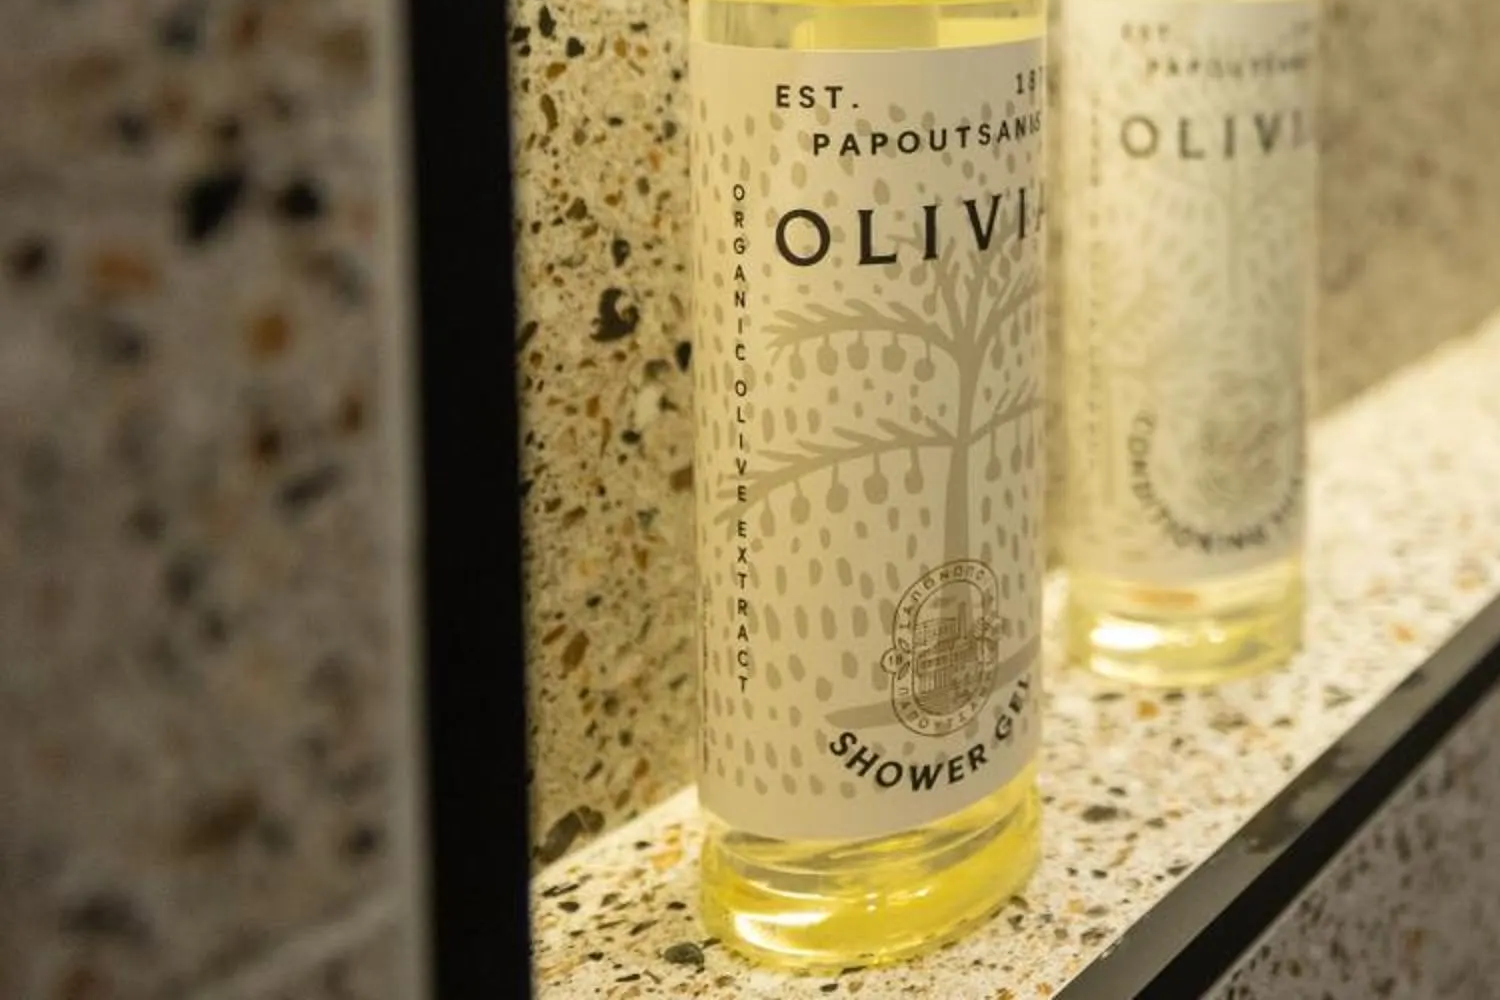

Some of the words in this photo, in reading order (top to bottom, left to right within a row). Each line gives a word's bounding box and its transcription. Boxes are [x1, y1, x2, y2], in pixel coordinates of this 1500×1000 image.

[775, 85, 860, 109] EST.
[1015, 66, 1043, 96] 18
[1120, 108, 1306, 161] OLIVI
[732, 184, 746, 361] ORGANIC
[734, 380, 748, 502] OLIVE
[736, 520, 749, 692] EXTRACT
[828, 731, 989, 793] SHOWER
[995, 672, 1032, 741] GEL
